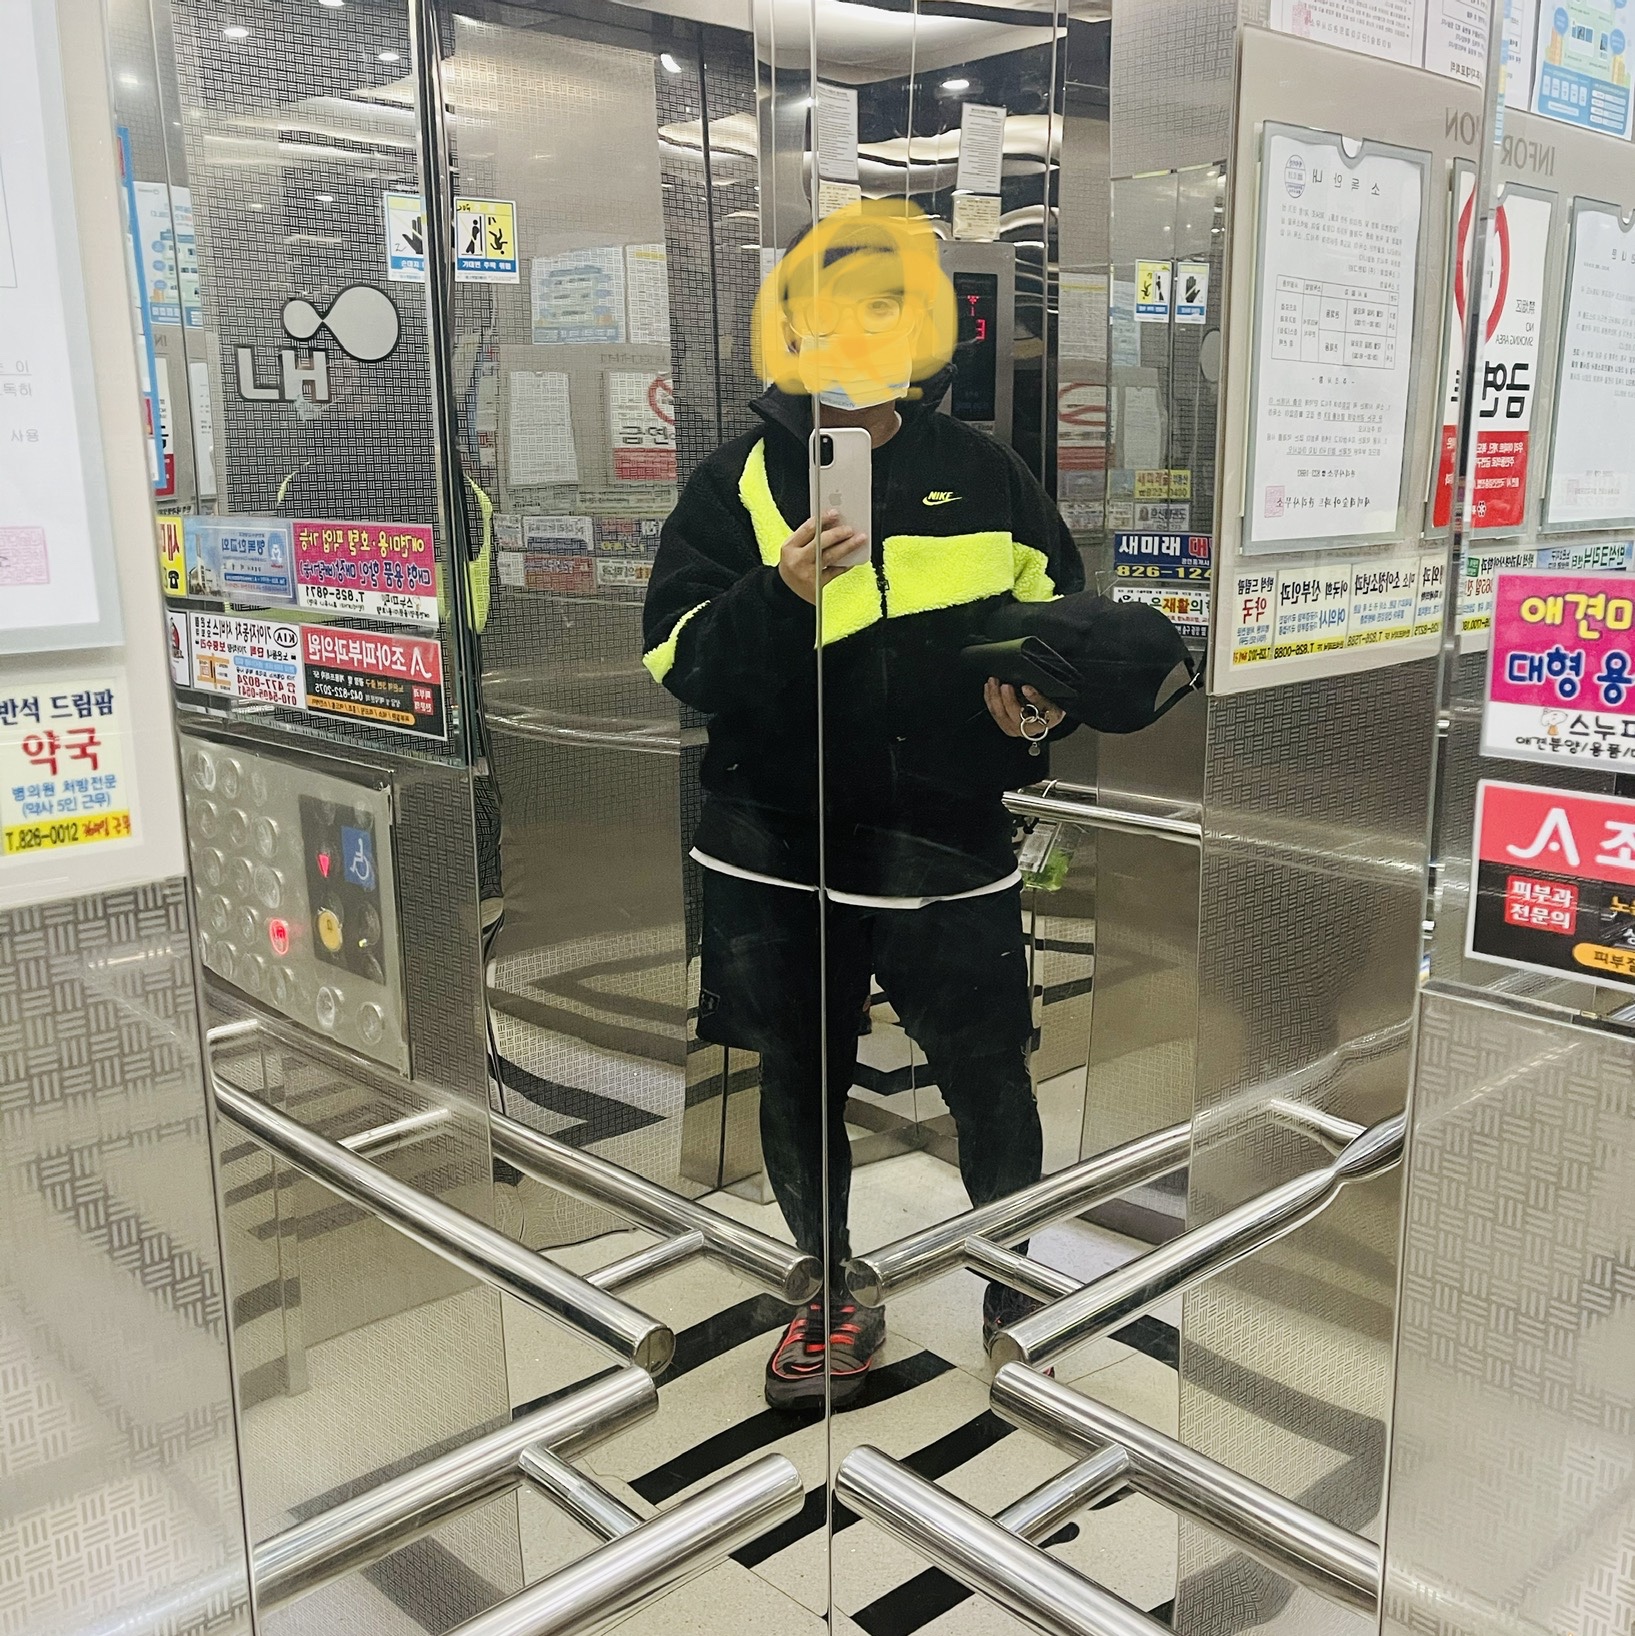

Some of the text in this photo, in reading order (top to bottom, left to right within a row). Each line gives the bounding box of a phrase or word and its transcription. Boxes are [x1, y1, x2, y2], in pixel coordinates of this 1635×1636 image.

[236, 348, 329, 401] LH
[0, 383, 32, 397] 독하
[928, 491, 953, 501] NIKE
[1119, 536, 1180, 556] 새미래
[1509, 647, 1633, 704] 대형 용
[51, 689, 114, 718] 드림팜
[22, 728, 101, 775] 약국
[12, 775, 116, 800] 병의원 처방전문
[22, 792, 111, 818] (약사 5인 근무)
[6, 823, 78, 850] T.826-0012
[1513, 881, 1573, 907] 피부과
[1511, 904, 1569, 929] 전문의
